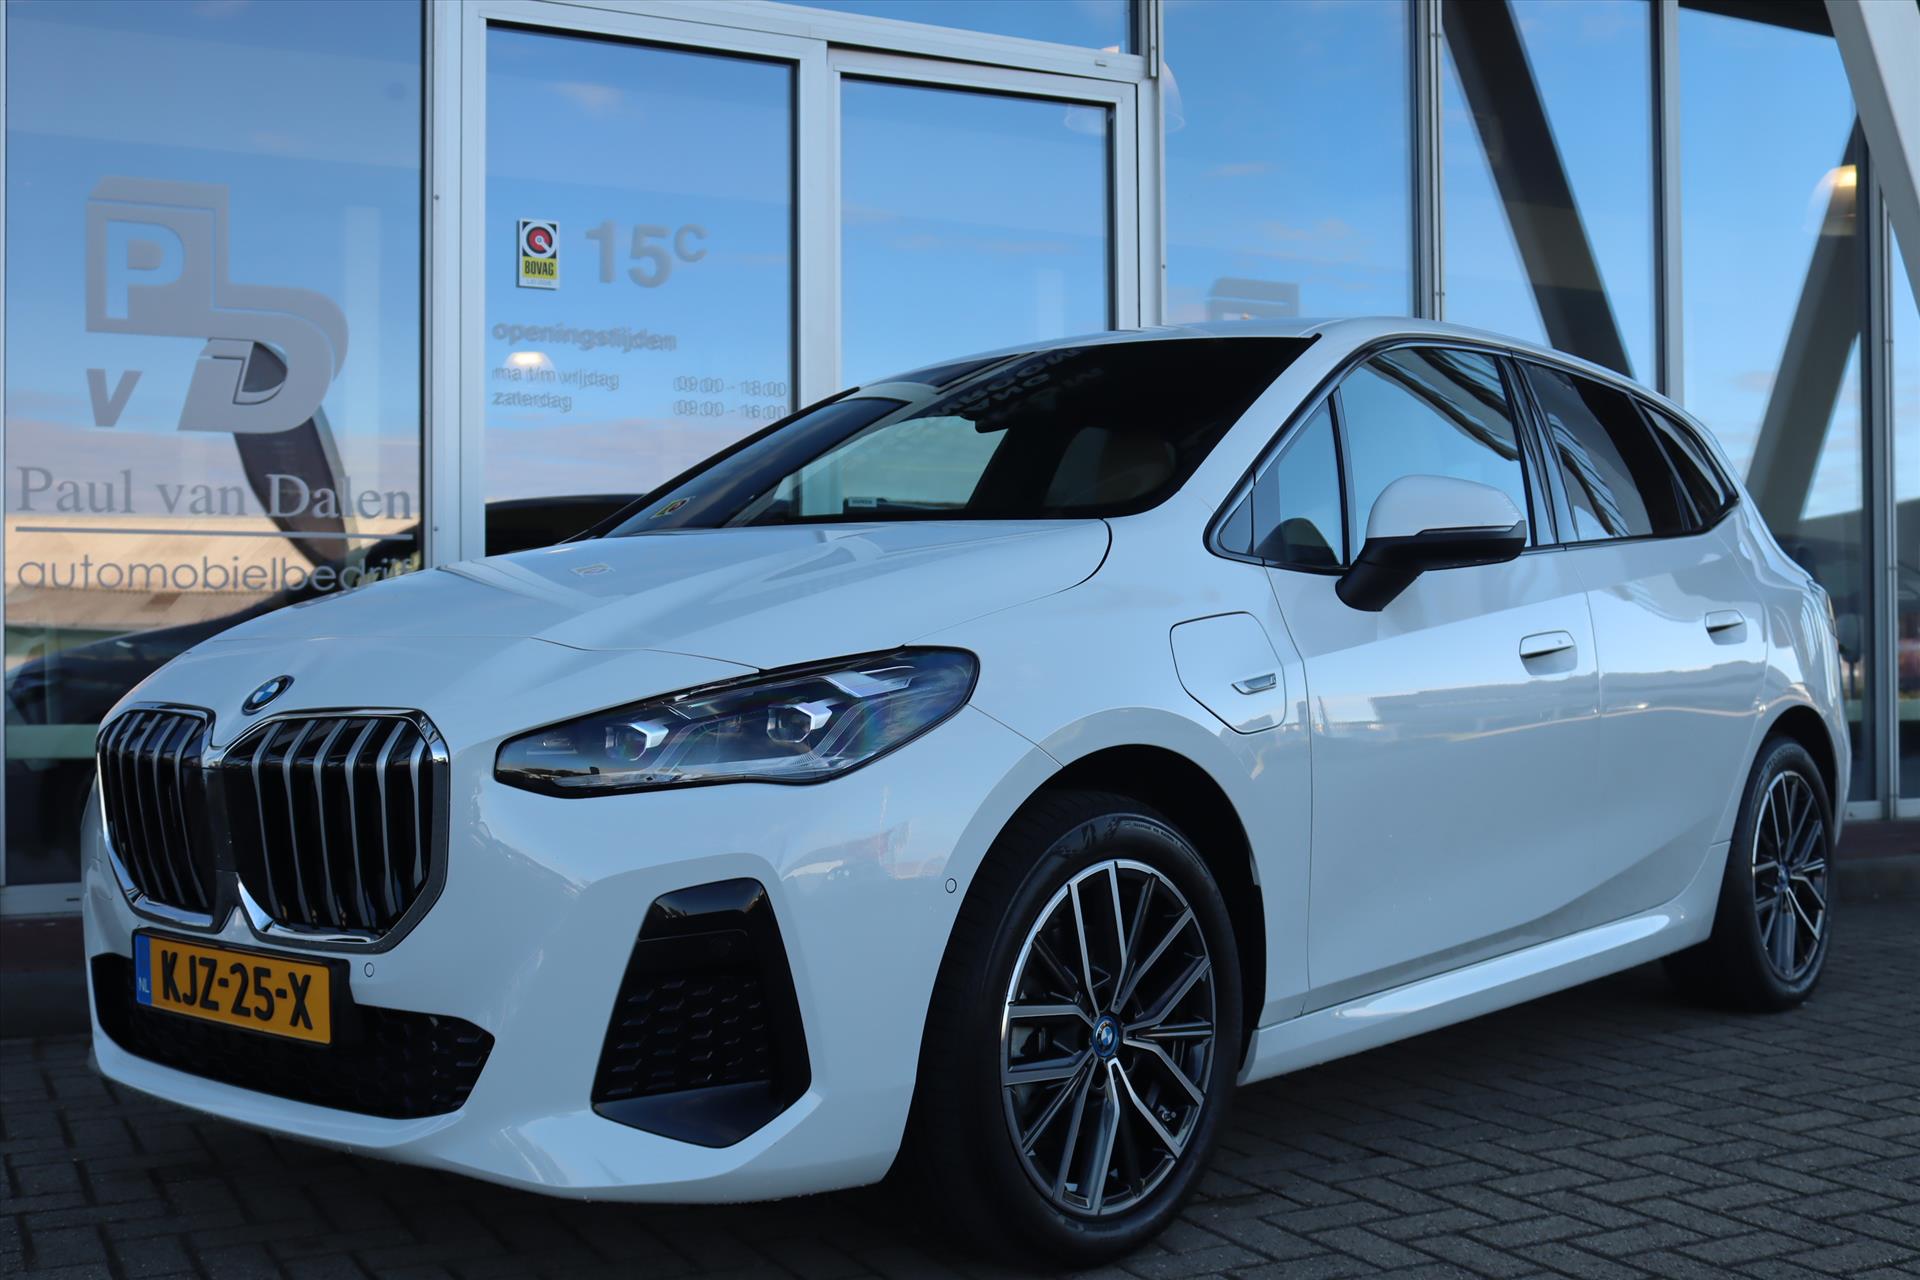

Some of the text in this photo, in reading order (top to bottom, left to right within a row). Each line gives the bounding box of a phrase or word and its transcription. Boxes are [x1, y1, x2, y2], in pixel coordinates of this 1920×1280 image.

[525, 260, 555, 277] BOVAG
[491, 322, 677, 352] openingstijden
[558, 367, 620, 391] vrijdag
[492, 390, 573, 413] zaterdag
[17, 465, 413, 520] Paul van Dalen
[138, 977, 151, 994] NL
[161, 949, 313, 1030] KJZ-25-X
